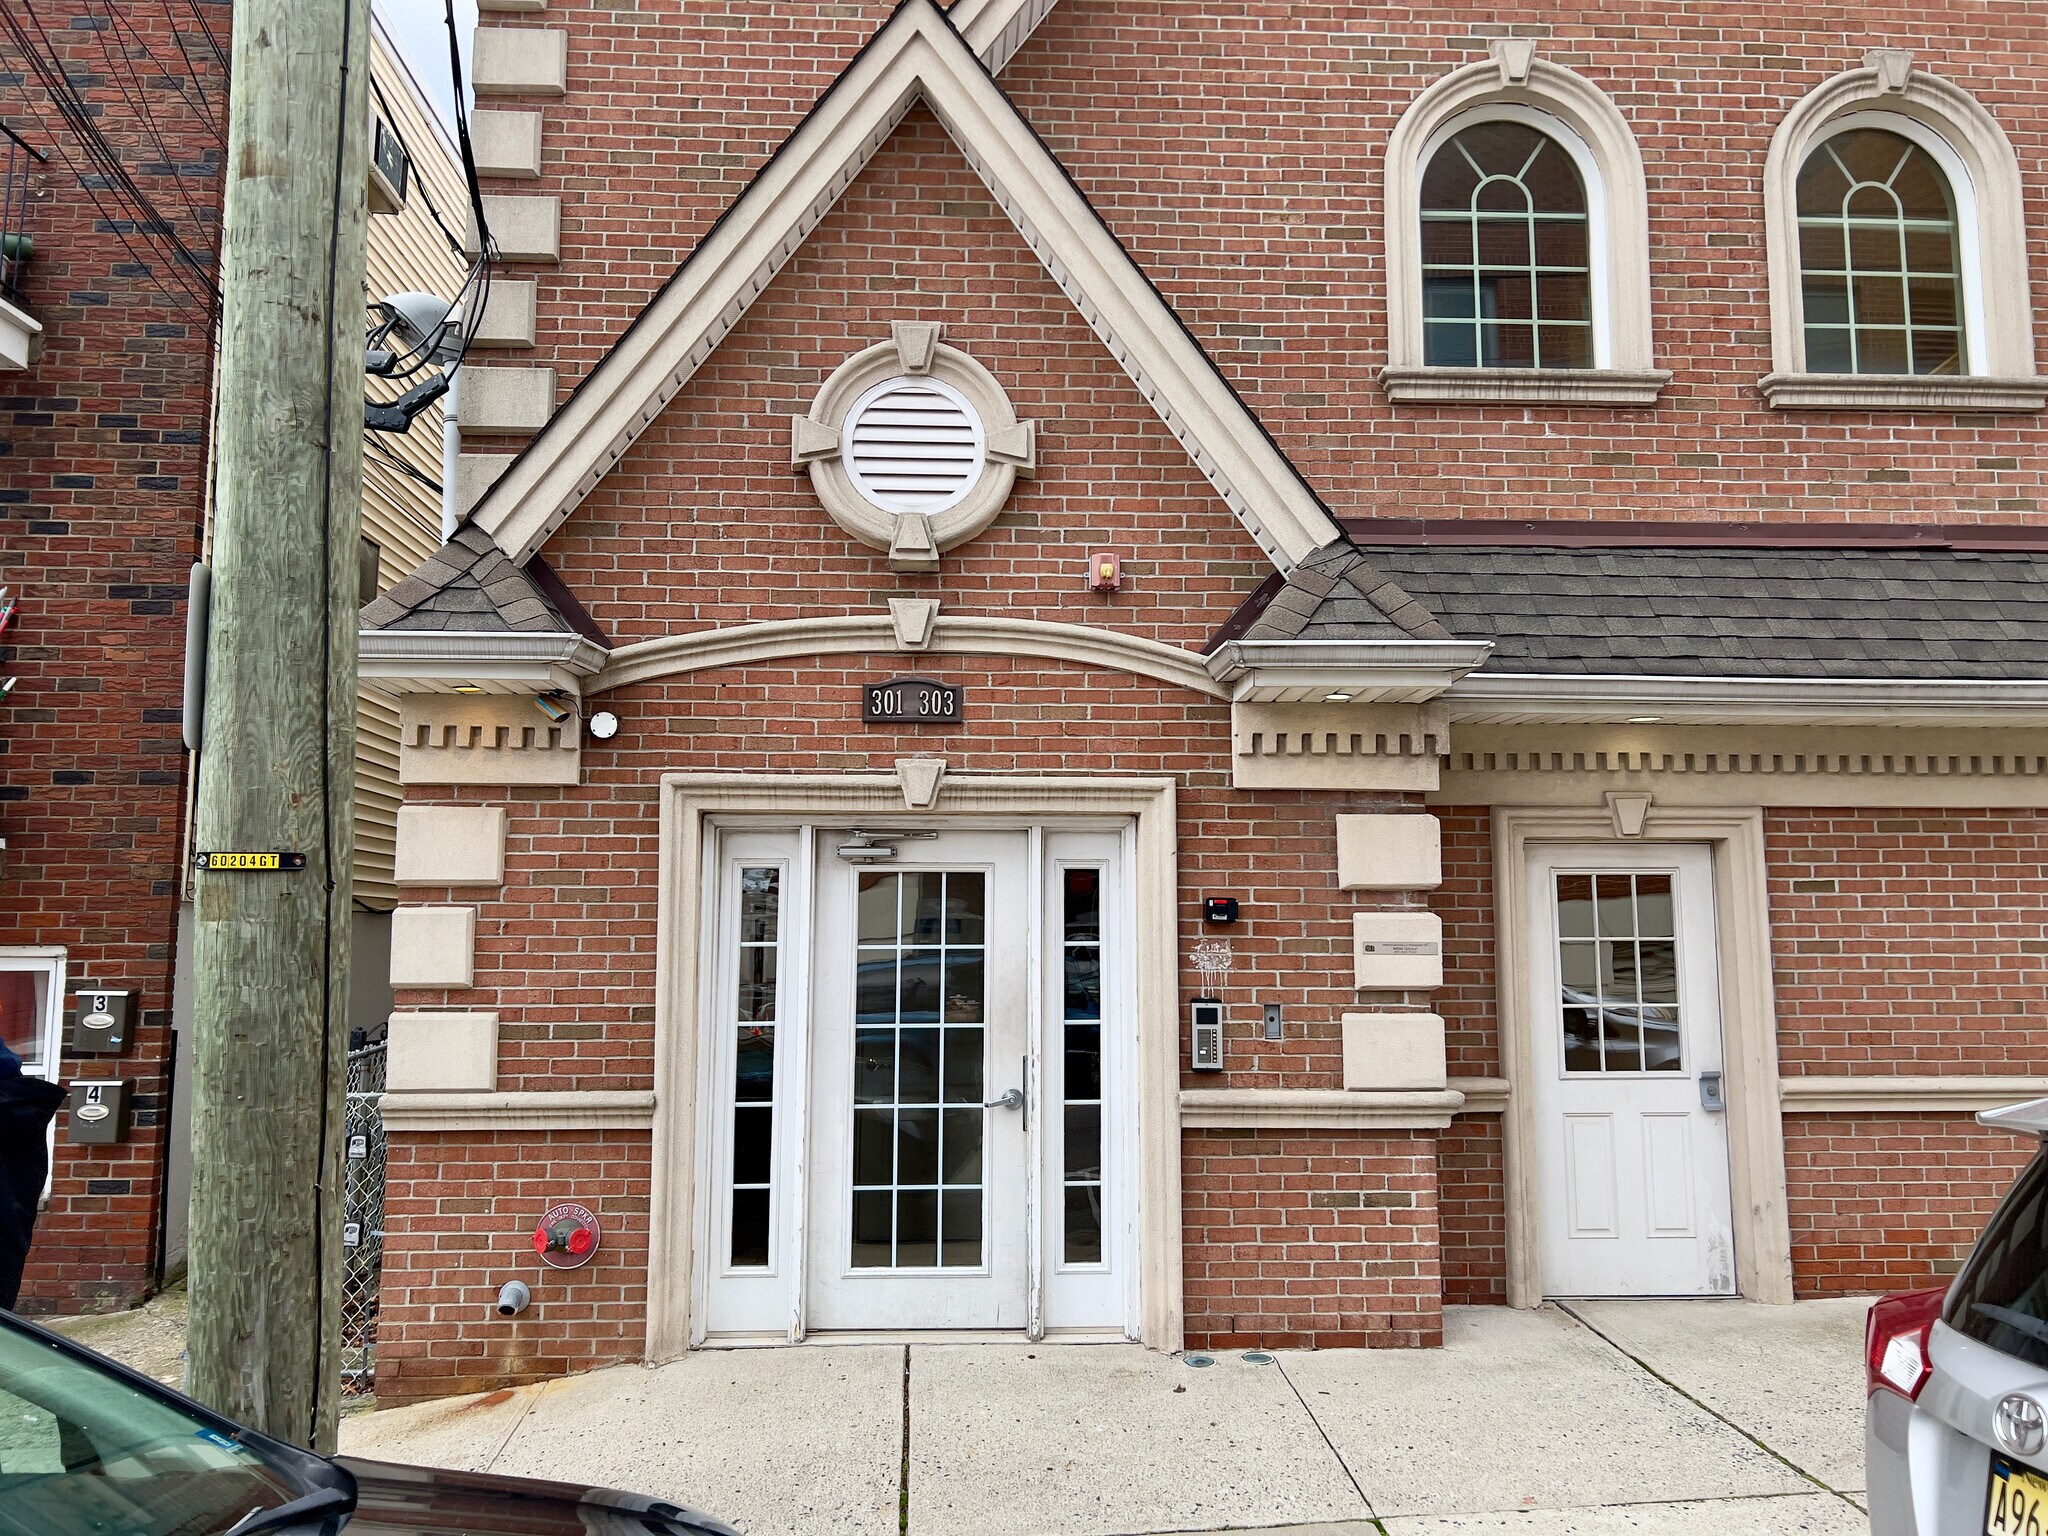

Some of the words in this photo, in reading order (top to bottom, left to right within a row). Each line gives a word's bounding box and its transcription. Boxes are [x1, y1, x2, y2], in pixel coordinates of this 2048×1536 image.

[871, 689, 903, 715] 301
[919, 690, 954, 716] 303
[211, 855, 277, 867] 60204GT
[95, 995, 106, 1012] 3
[88, 1086, 100, 1102] 4
[547, 1206, 569, 1221] AUTO
[573, 1207, 593, 1224] SPKR
[1993, 1481, 2040, 1536] A96
